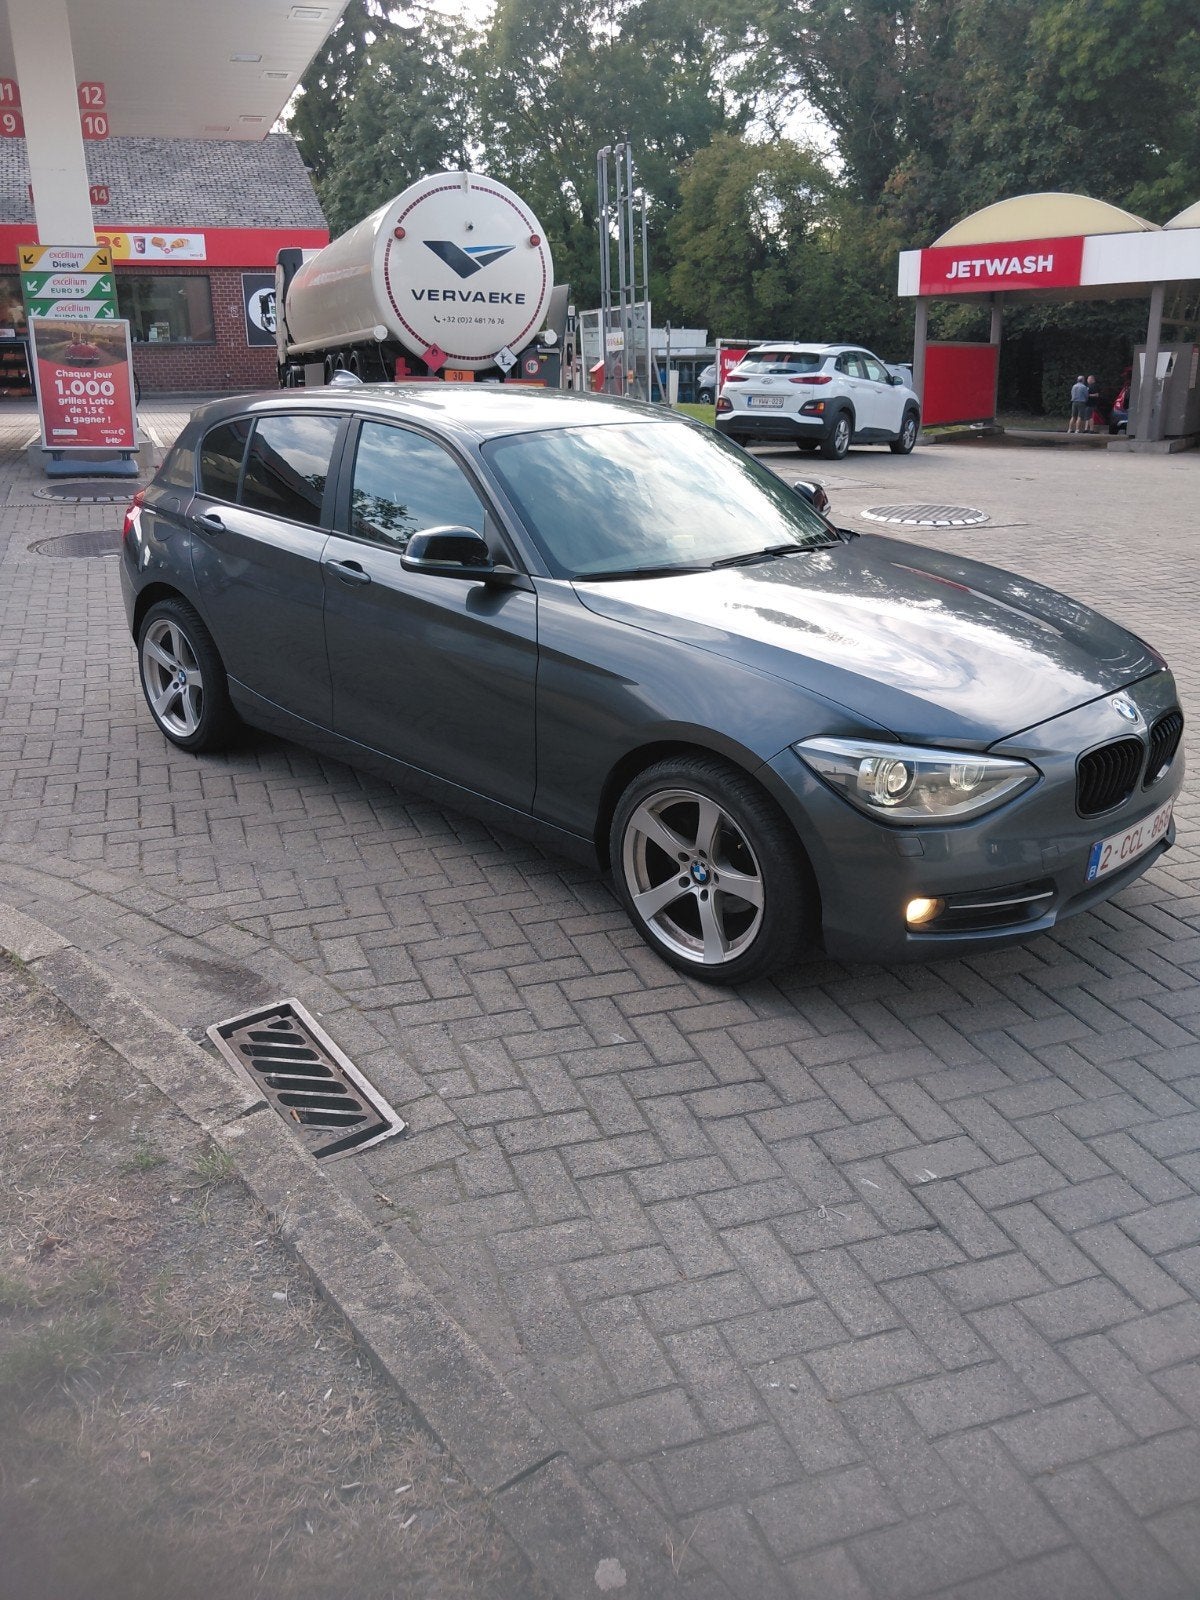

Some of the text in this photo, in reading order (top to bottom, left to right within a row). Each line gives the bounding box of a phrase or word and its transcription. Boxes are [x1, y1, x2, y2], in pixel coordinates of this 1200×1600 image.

[81, 86, 104, 104] 12
[3, 113, 16, 132] 9
[85, 116, 107, 134] 10
[92, 188, 107, 201] 14
[52, 260, 79, 268] Diesel
[946, 254, 1053, 279] JETWASH
[52, 277, 88, 286] excellium
[411, 289, 526, 305] VERVAEKE
[56, 304, 91, 312] excellium
[457, 316, 472, 325] (0)2
[55, 369, 113, 379] Chaque jour
[54, 380, 115, 396] 1.000
[58, 397, 115, 406] grilles Lotto
[64, 415, 71, 423] à
[73, 416, 106, 424] gagner
